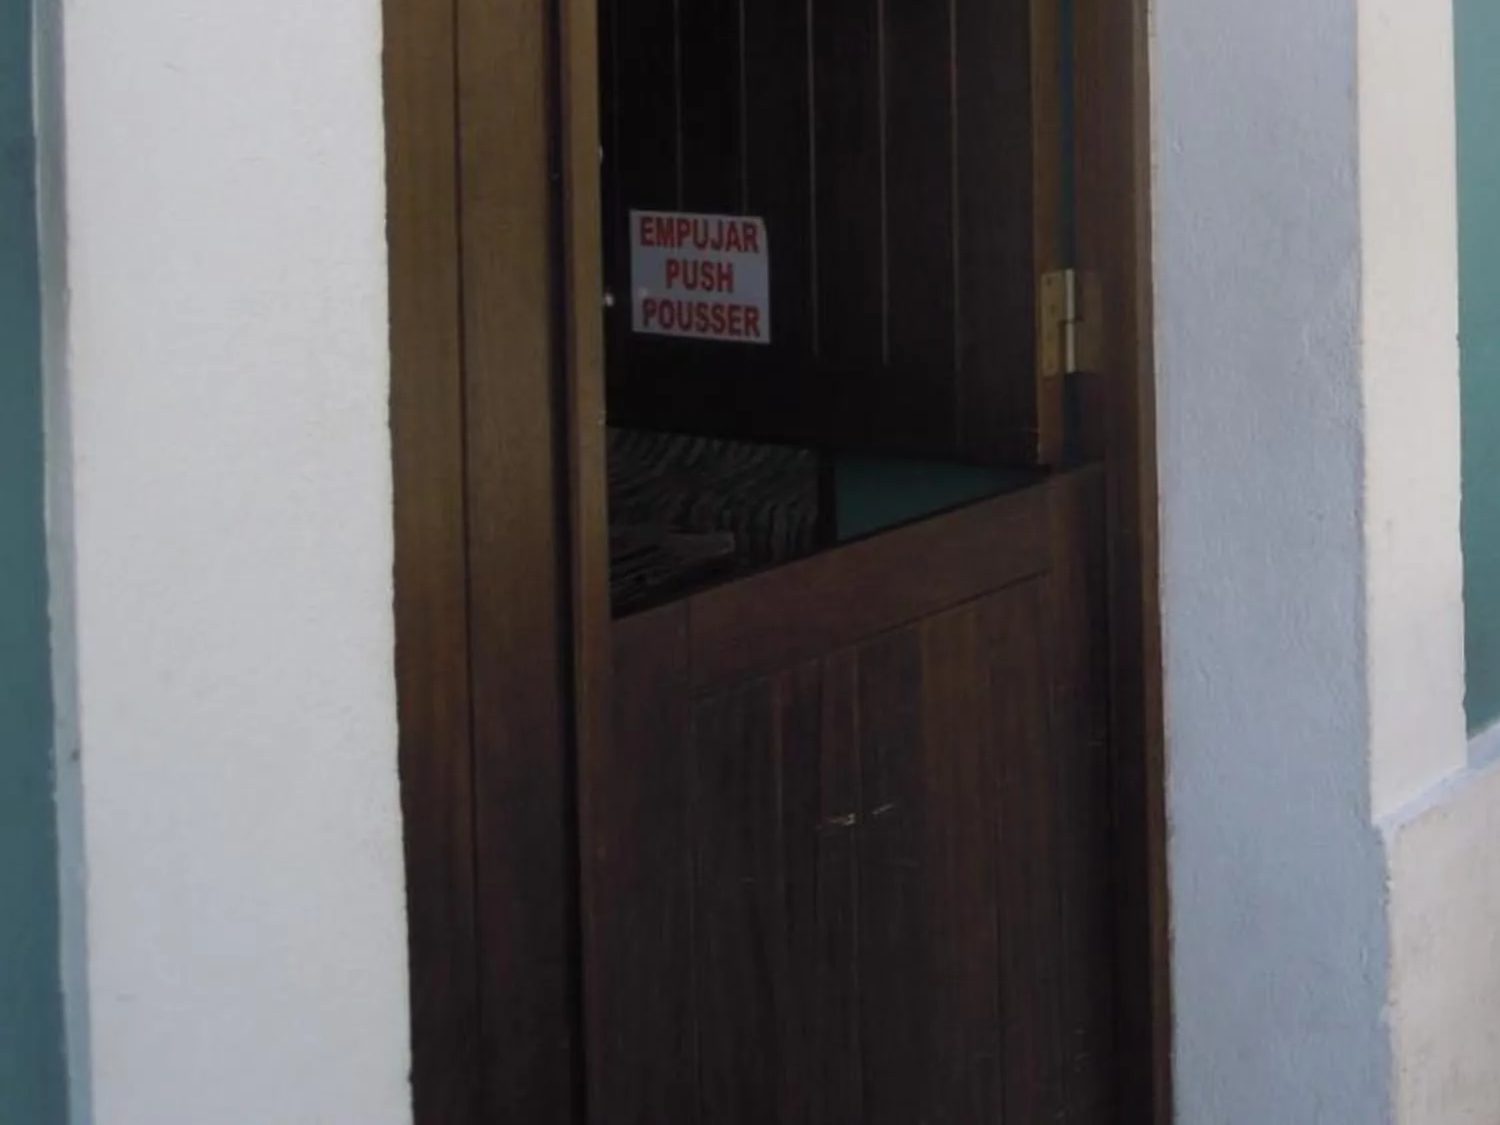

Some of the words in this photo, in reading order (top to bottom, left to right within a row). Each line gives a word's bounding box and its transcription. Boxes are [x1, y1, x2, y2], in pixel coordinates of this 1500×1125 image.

[639, 216, 760, 254] EMPUJAR
[665, 258, 735, 293] PUSH
[642, 298, 761, 338] POUSSER
